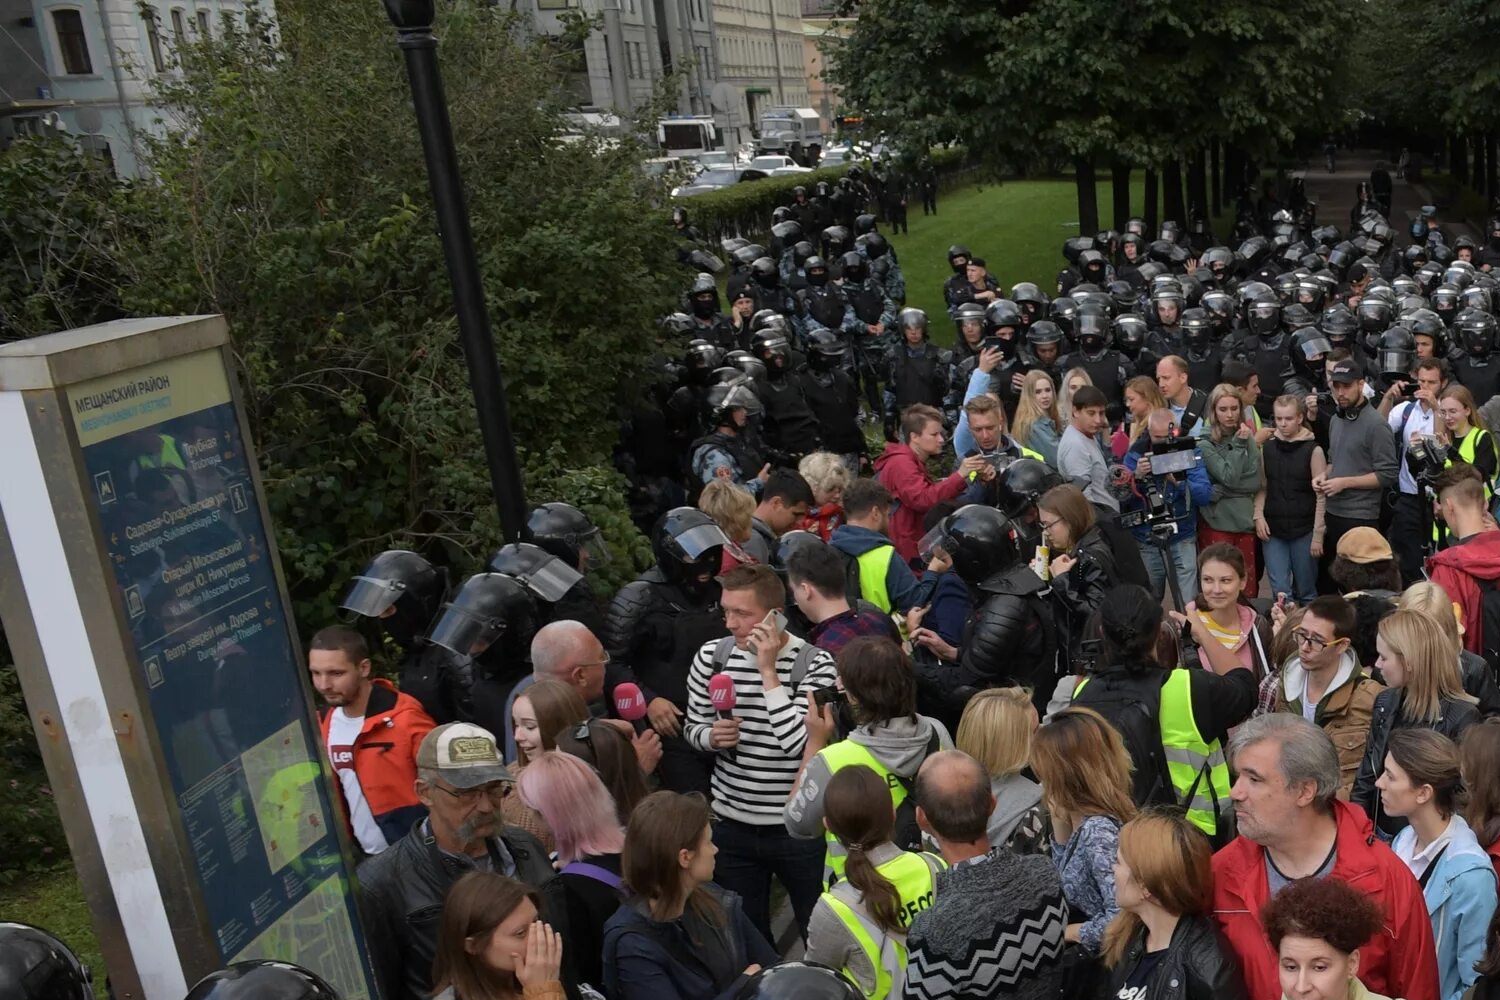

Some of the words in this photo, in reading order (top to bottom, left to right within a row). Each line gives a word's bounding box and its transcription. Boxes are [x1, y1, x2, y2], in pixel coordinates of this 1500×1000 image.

[75, 382, 137, 414] МЕЩАНСКИЙ
[138, 375, 170, 395] РАЙОН
[183, 437, 216, 457] Трубная
[162, 562, 192, 584] Старый
[192, 540, 242, 569] Московский
[175, 581, 195, 598] цирк
[208, 557, 247, 581] Никулина
[202, 583, 229, 601] Moscow
[229, 573, 250, 589] Circus
[163, 644, 187, 662] Театр
[187, 629, 214, 650] зверей
[215, 622, 228, 635] им.
[229, 608, 259, 630] Дурова
[238, 622, 262, 640] Theatre
[333, 751, 353, 763] Lev
